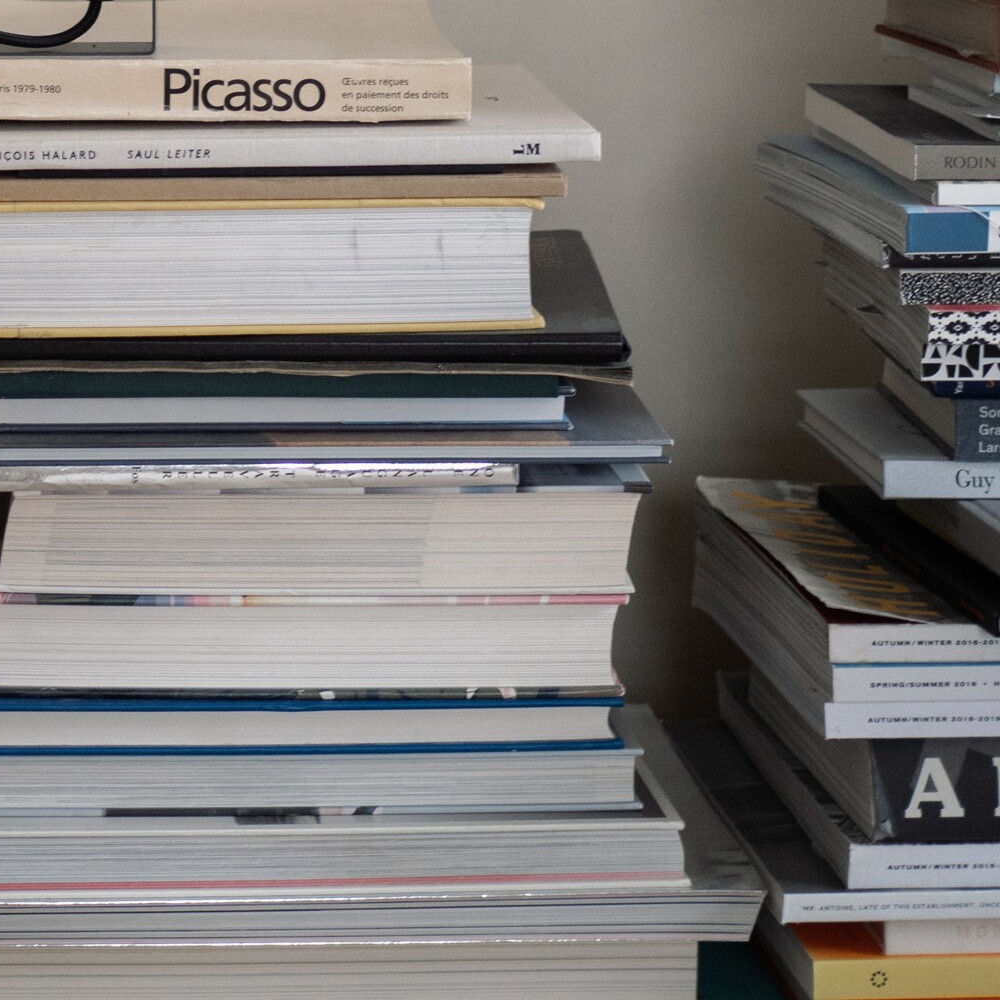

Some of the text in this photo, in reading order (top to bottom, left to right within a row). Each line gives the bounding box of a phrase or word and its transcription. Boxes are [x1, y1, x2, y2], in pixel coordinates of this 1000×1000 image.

[13, 84, 61, 94] 1979-1980
[379, 77, 409, 89] reçues
[163, 68, 326, 112] Picasso
[341, 89, 449, 103] en paiement des droits
[341, 103, 404, 113] de succession
[42, 150, 97, 161] HALARD
[127, 148, 211, 160] SAUL LEITER
[944, 156, 997, 169] RODIN
[978, 441, 1000, 453] Lar
[162, 467, 494, 479] ONE LANGUAGE TRAVELLER
[955, 469, 994, 494] Guy
[904, 756, 1000, 818] A
